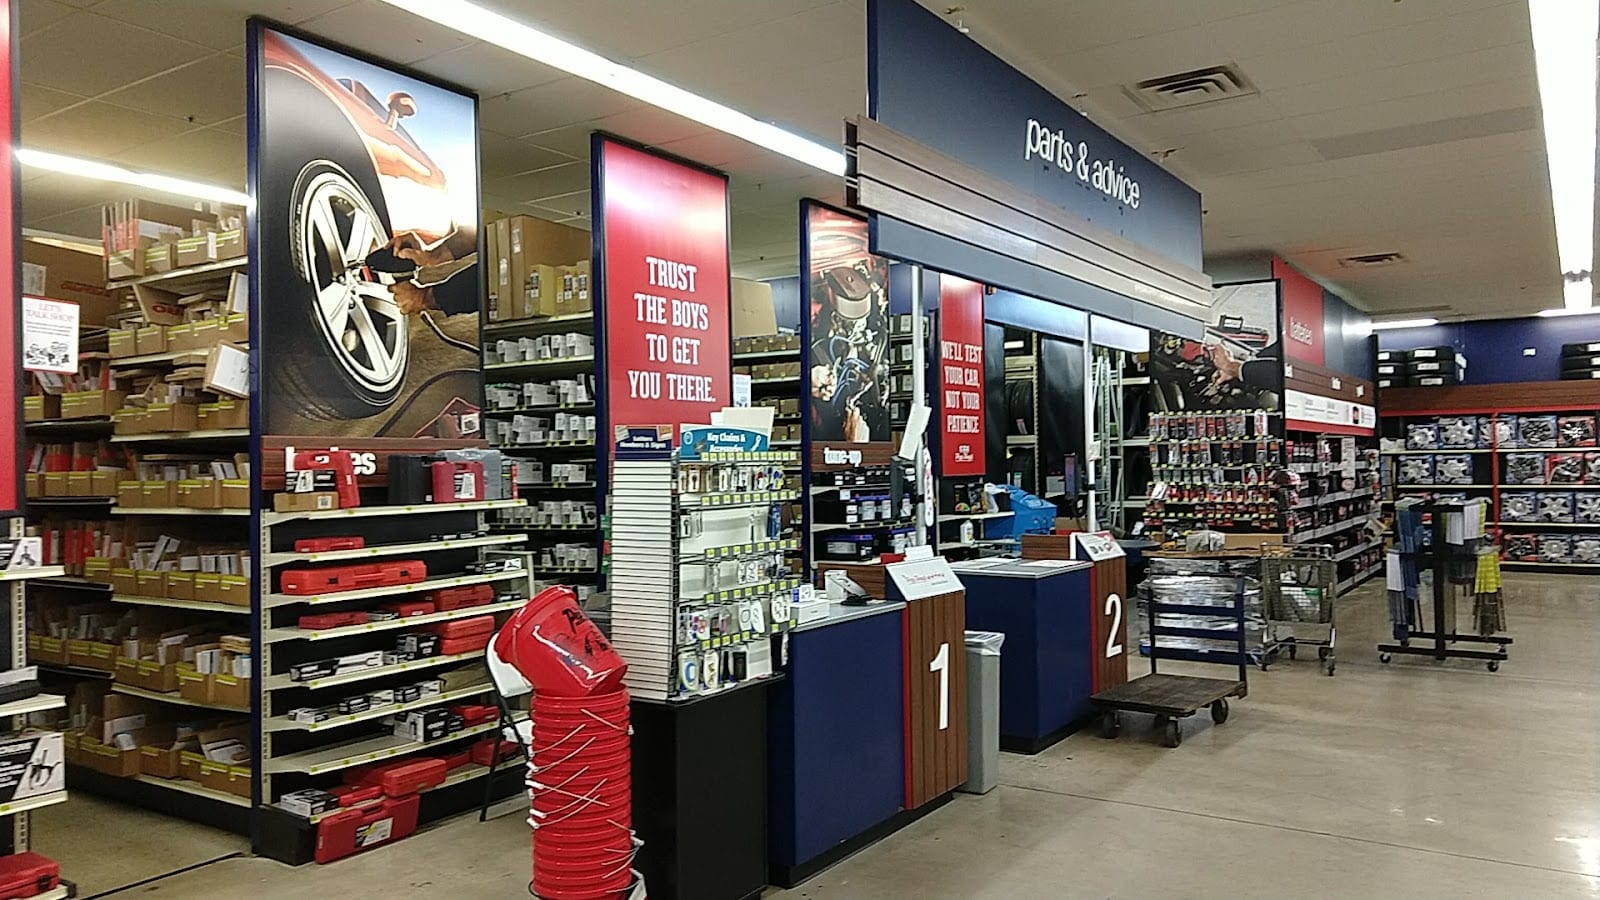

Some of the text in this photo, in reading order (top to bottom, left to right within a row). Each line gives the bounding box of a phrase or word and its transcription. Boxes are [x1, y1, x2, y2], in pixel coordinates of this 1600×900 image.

[1025, 119, 1140, 209] parts & advice
[645, 256, 697, 292] TRUST
[634, 293, 709, 331] THE BOYS
[645, 333, 700, 365] TO GET
[941, 340, 982, 364] WE'LL TEST
[627, 370, 661, 399] YOU
[666, 373, 716, 402] THERE.
[944, 365, 963, 385] YOUR
[945, 390, 980, 410] NOT YOUR
[946, 415, 979, 433] PATIENCE
[1104, 593, 1122, 658] 2
[929, 643, 949, 730] 1
